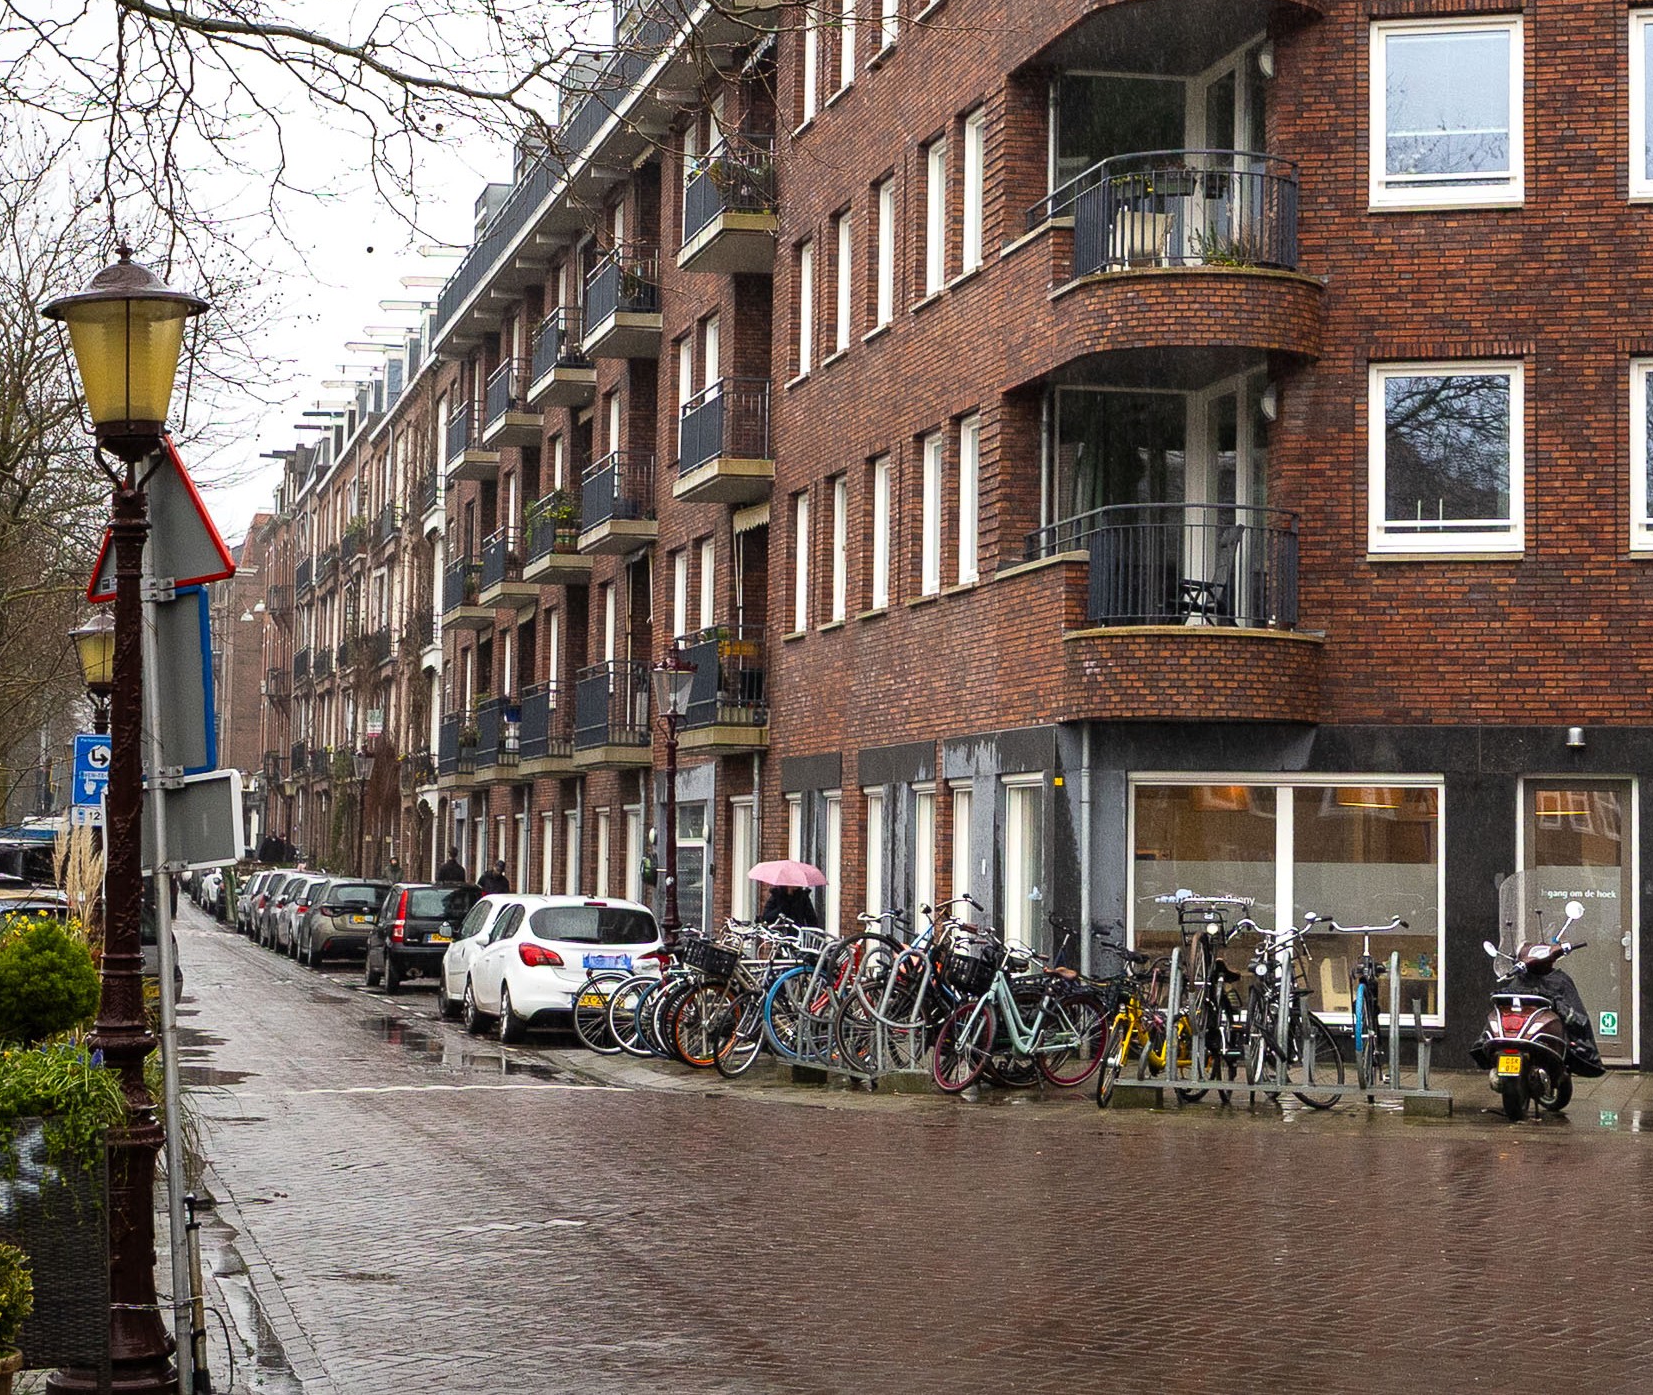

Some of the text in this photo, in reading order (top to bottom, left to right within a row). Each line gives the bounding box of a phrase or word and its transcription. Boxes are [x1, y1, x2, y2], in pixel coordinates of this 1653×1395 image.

[1569, 890, 1583, 898] om
[1584, 889, 1596, 898] de
[1596, 889, 1617, 898] hoek
